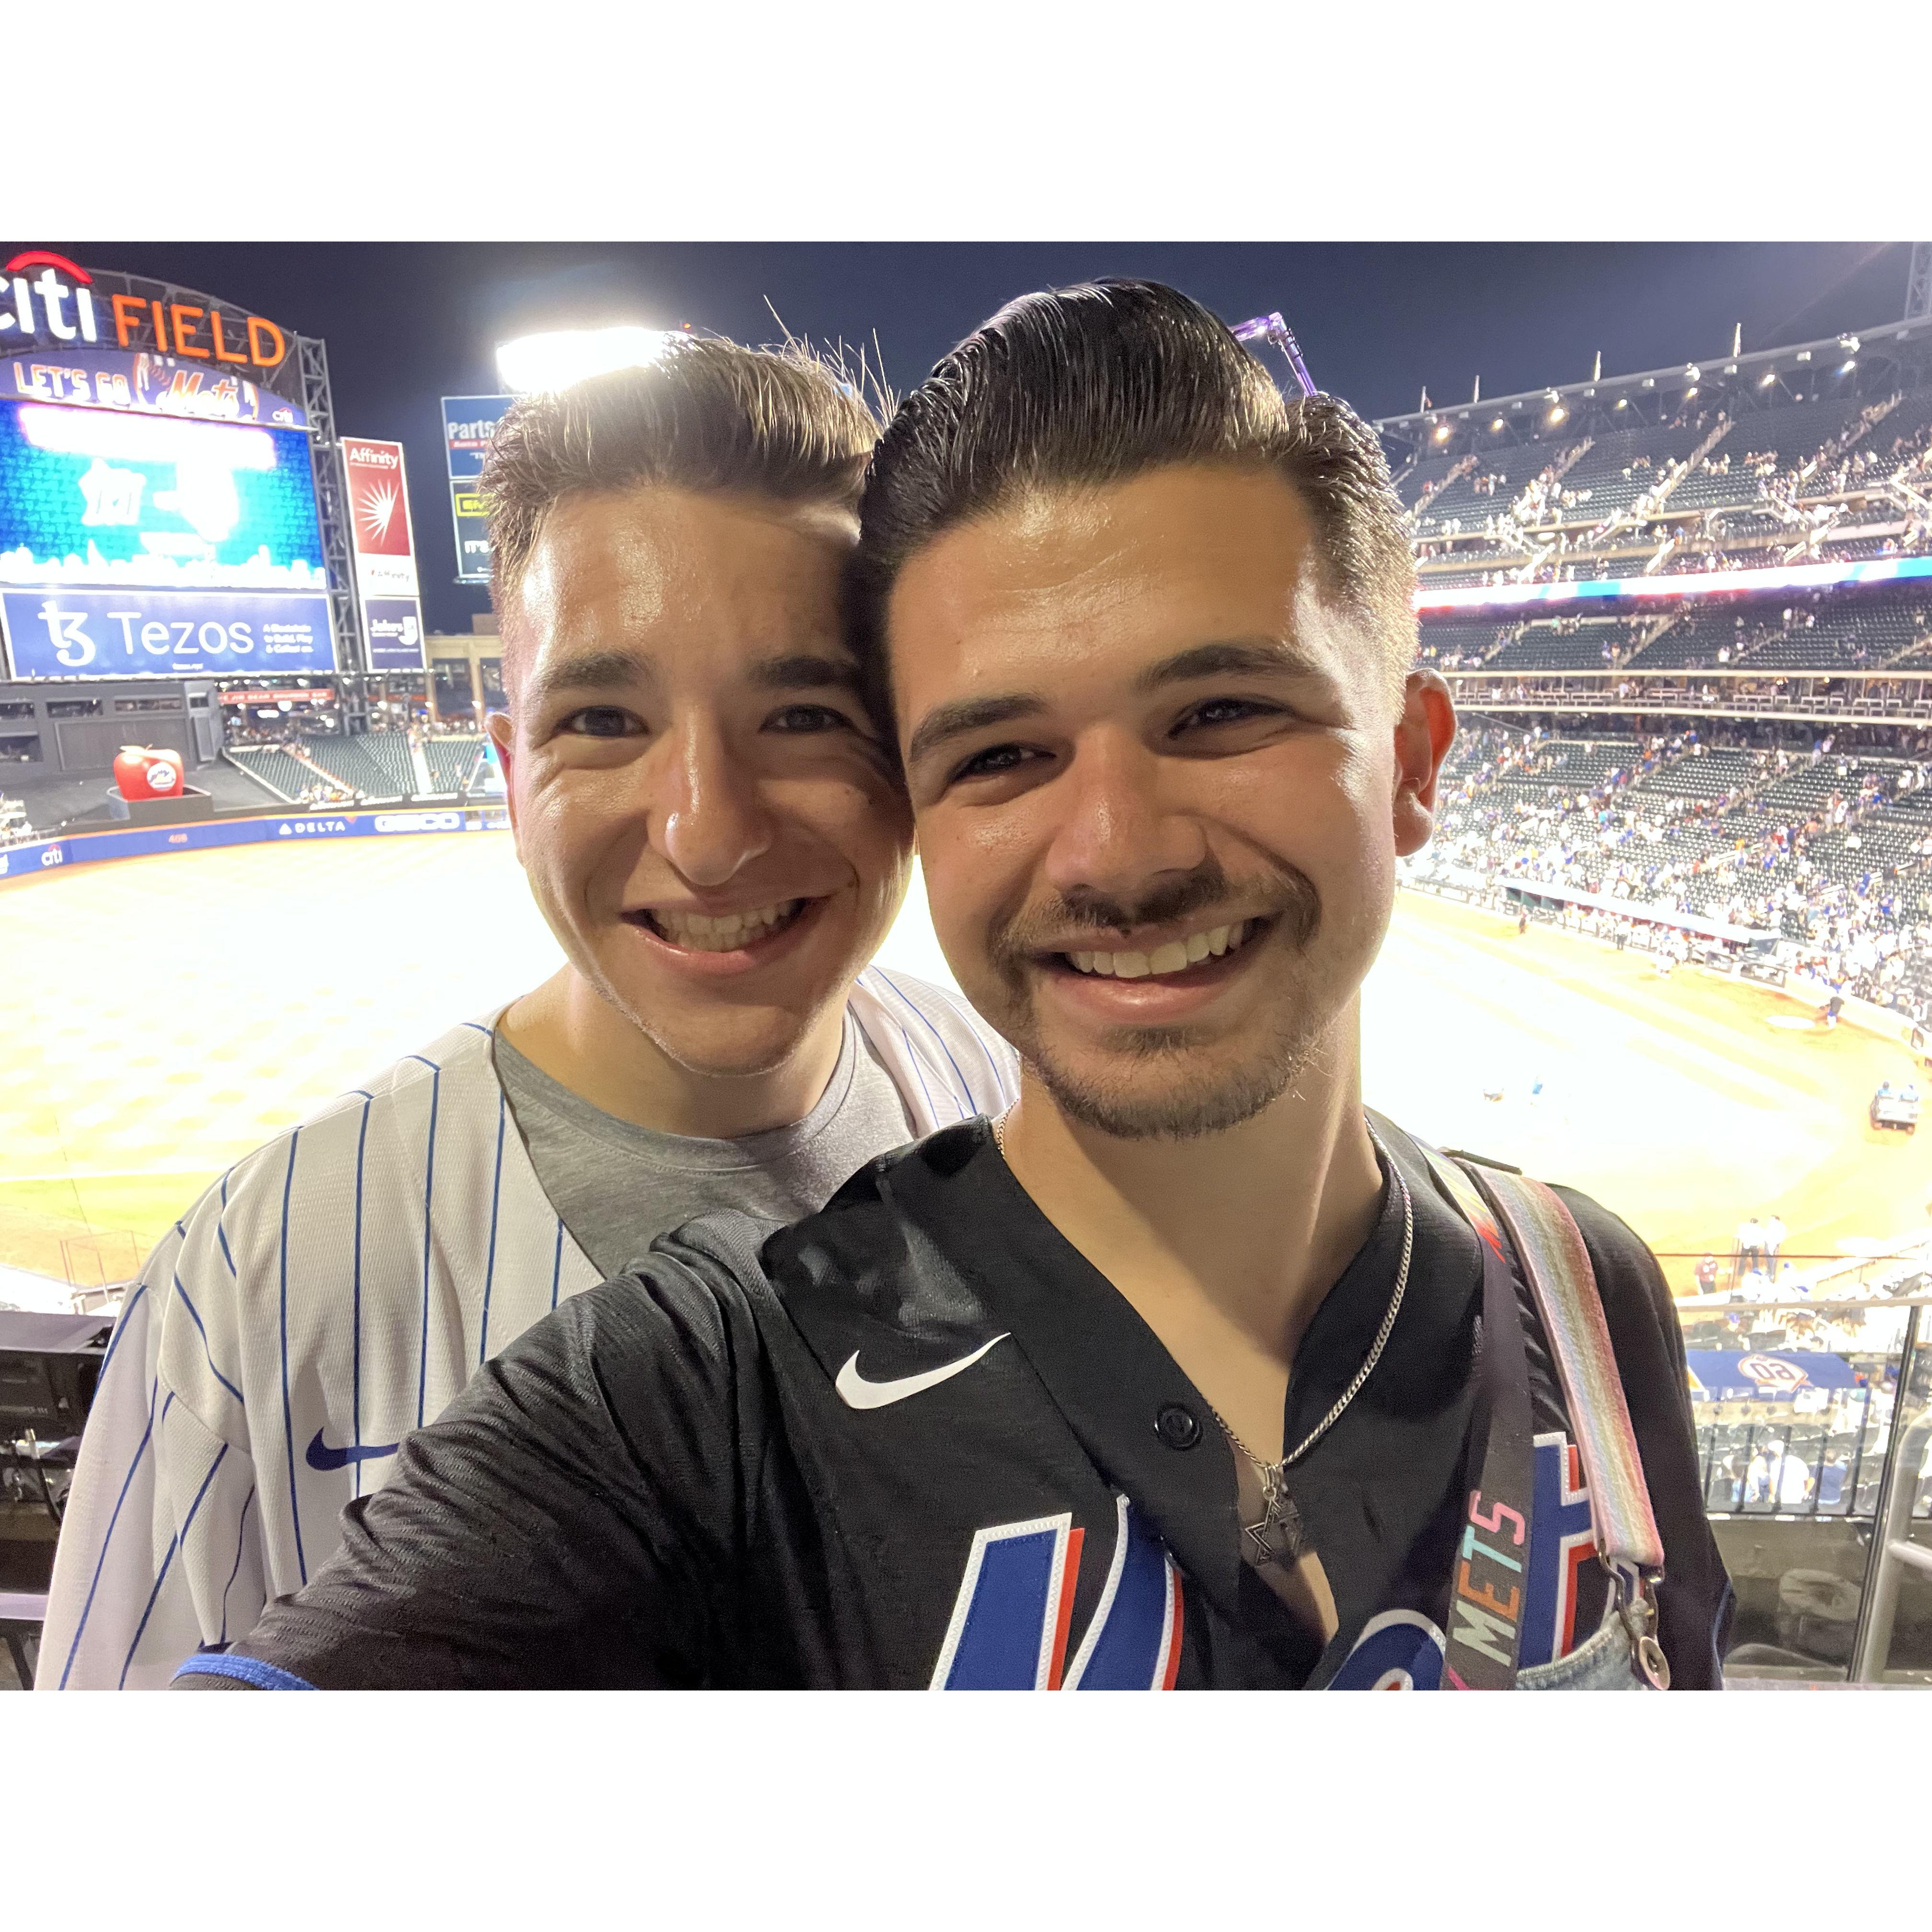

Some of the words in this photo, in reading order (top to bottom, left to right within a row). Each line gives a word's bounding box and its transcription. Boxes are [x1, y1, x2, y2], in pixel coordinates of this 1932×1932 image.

[112, 294, 285, 367] FIELD
[13, 362, 91, 402] LET'S
[96, 372, 131, 405] GO
[349, 447, 399, 470] Affinity
[107, 612, 254, 655] Tezos
[295, 821, 345, 834] DELTA
[375, 813, 460, 833] GEICO
[1452, 1490, 1525, 1667] METS
